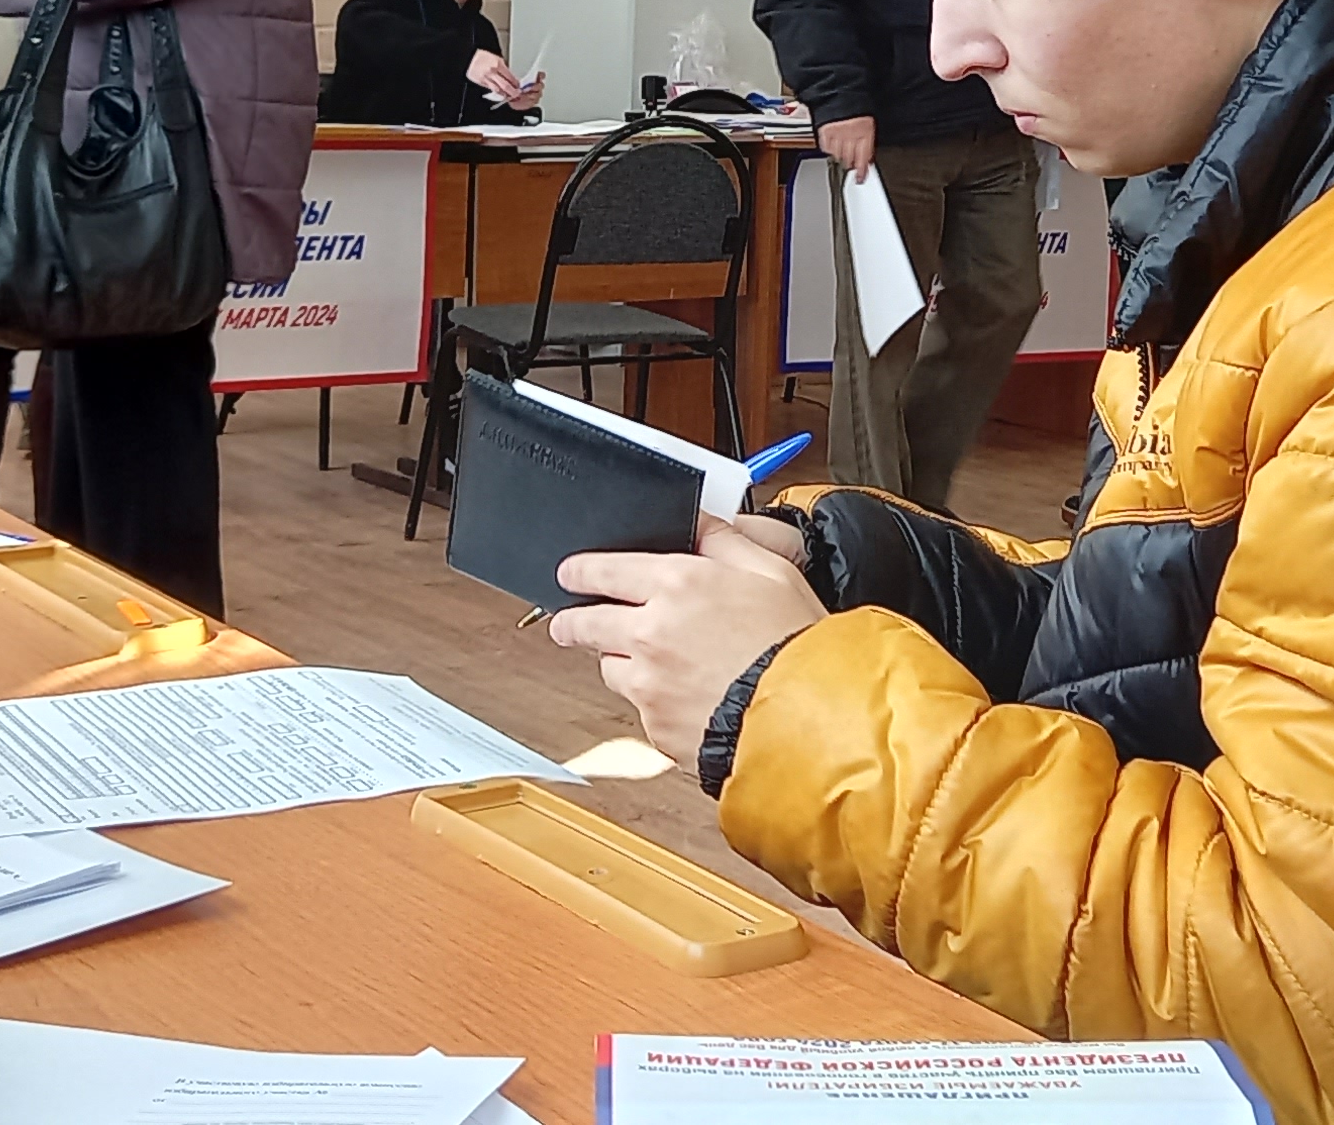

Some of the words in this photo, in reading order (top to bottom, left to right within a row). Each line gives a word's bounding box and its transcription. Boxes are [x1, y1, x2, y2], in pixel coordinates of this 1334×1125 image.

[222, 305, 289, 330] МАРТА
[290, 304, 339, 328] 2024
[1122, 425, 1173, 456] bia
[1113, 460, 1173, 476] mpany
[647, 1052, 813, 1071] ФЕДЕРАЦИИ
[822, 1057, 1003, 1072] РОССИЙСКОЙ
[1011, 1052, 1186, 1068] ПРЕЗИДЕНТА
[1083, 1065, 1201, 1076] Приглашаем
[933, 1080, 1081, 1090] УВАЖАЕМЫЕ
